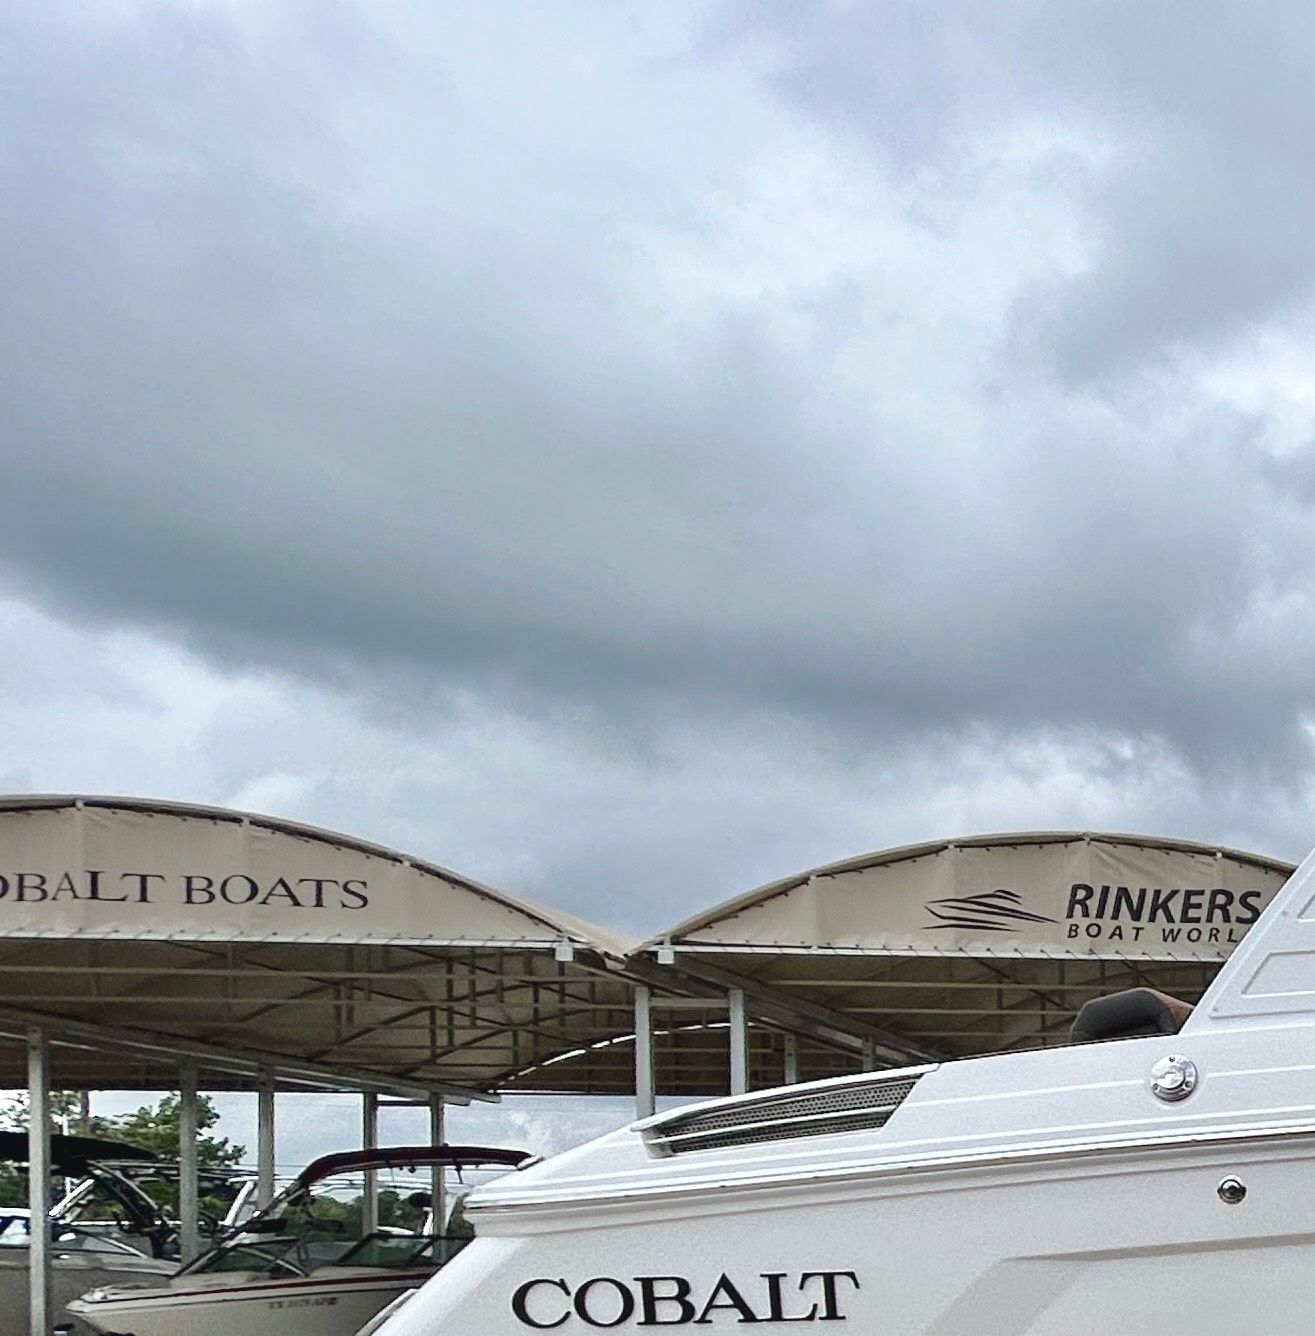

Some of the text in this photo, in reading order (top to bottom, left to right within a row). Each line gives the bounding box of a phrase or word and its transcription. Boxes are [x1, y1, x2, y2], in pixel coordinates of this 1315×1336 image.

[0, 870, 369, 909] BALT BOATS
[1066, 883, 1262, 924] RINKERS
[1067, 923, 1240, 944] BOAT WORL
[511, 1271, 861, 1330] COBALT
